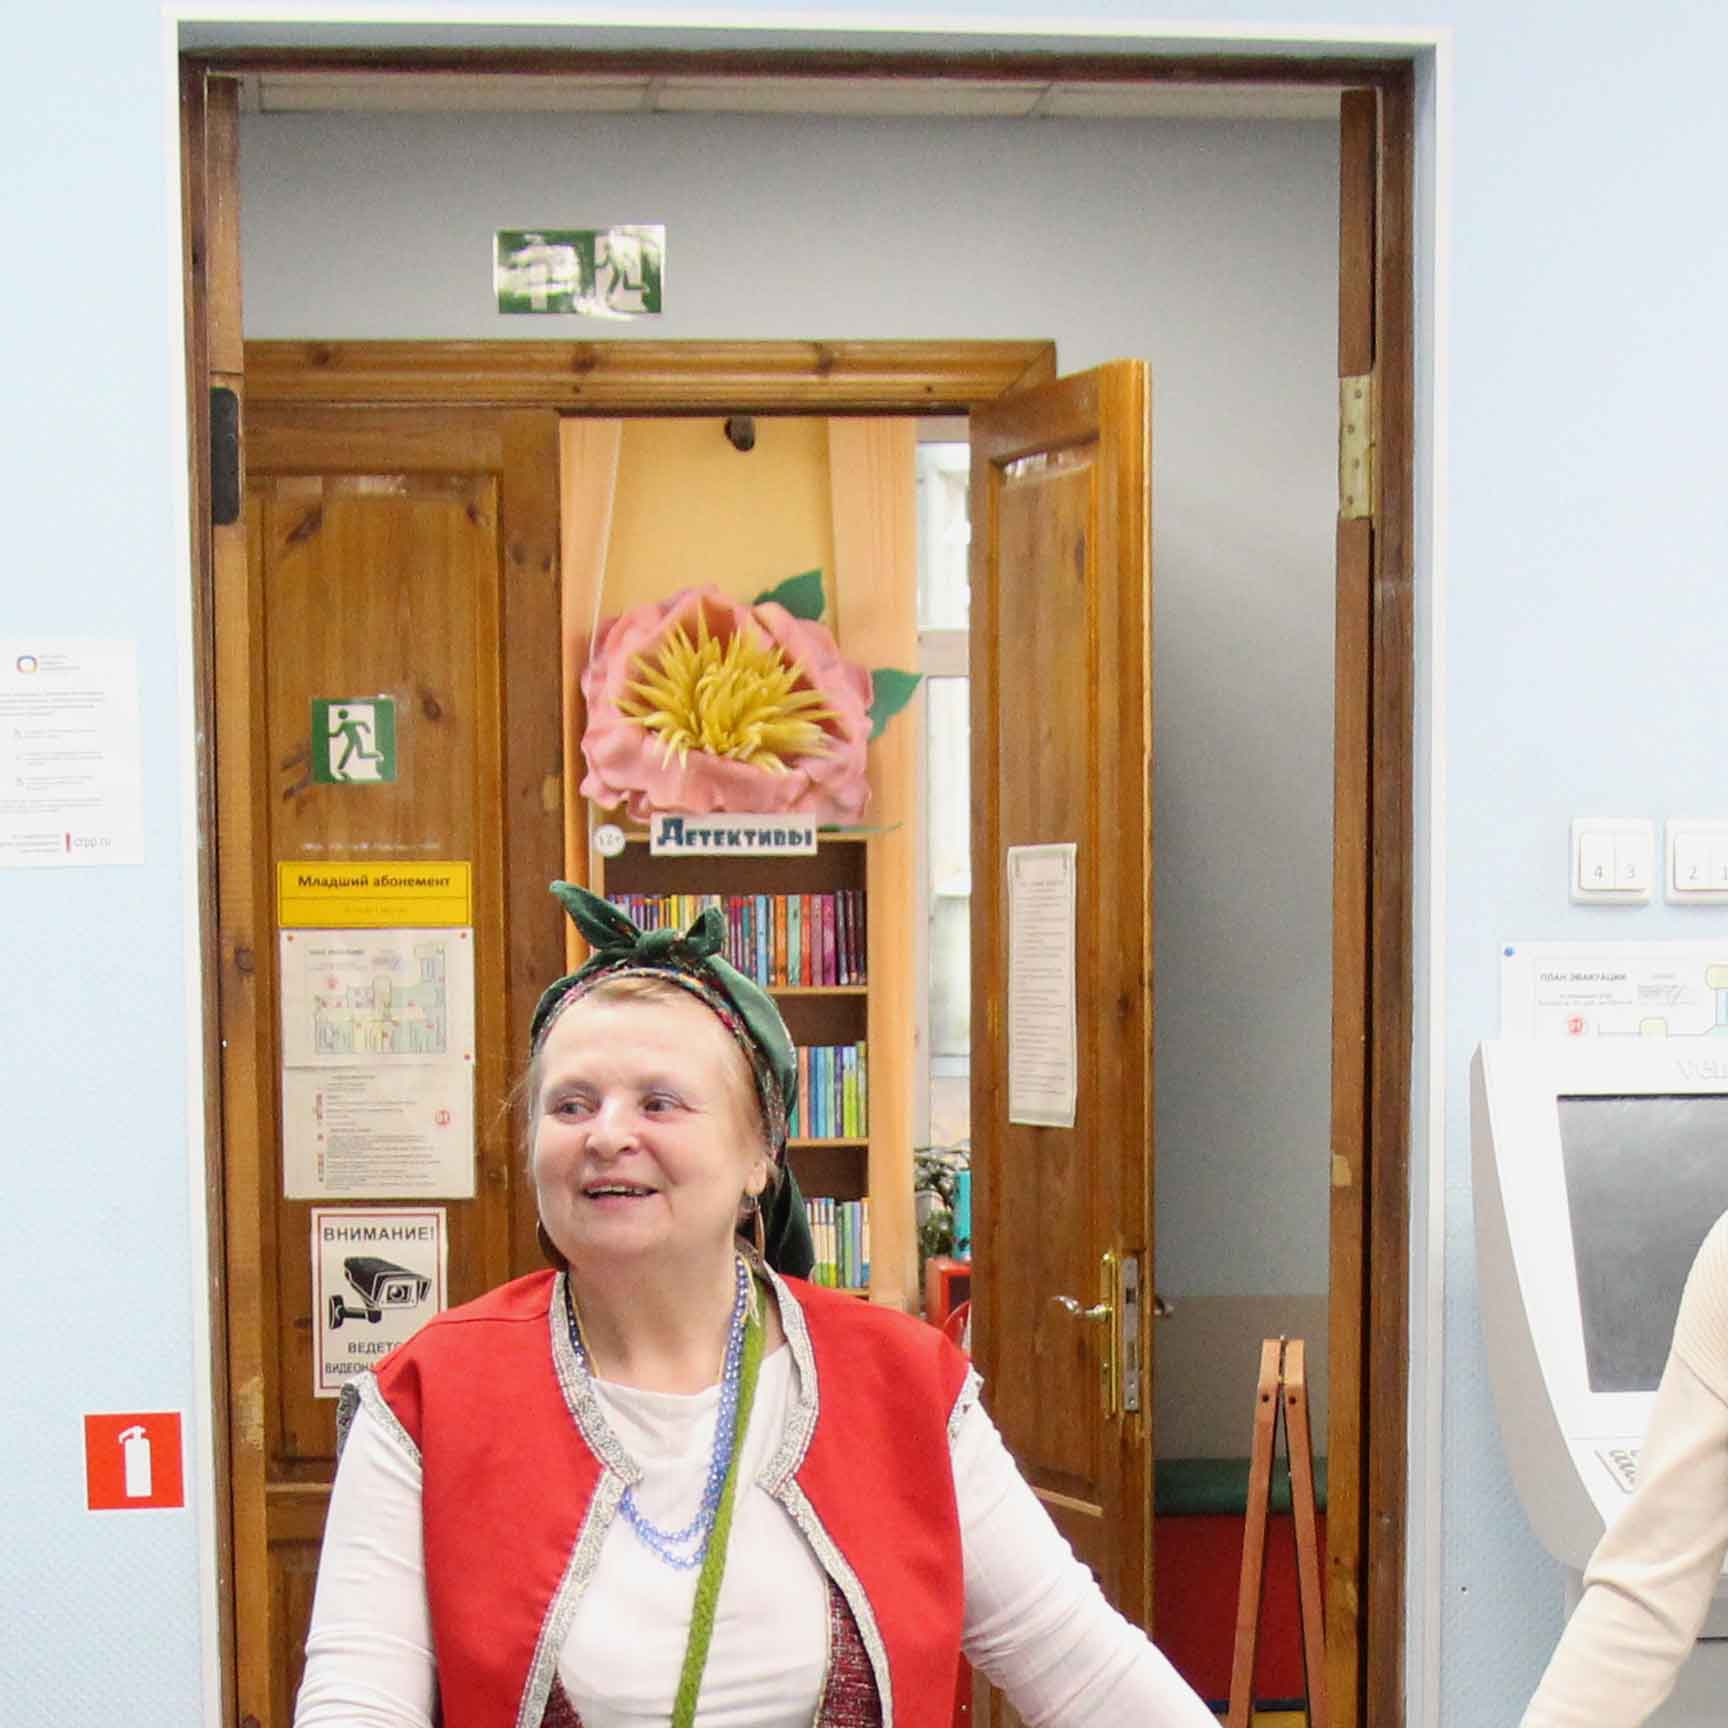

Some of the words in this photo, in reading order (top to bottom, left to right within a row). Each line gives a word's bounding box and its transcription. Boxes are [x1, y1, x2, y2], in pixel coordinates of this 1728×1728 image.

[298, 873, 369, 889] Младший
[373, 873, 451, 887] абонемент
[323, 1226, 435, 1242] ВНИМАНИЕ!
